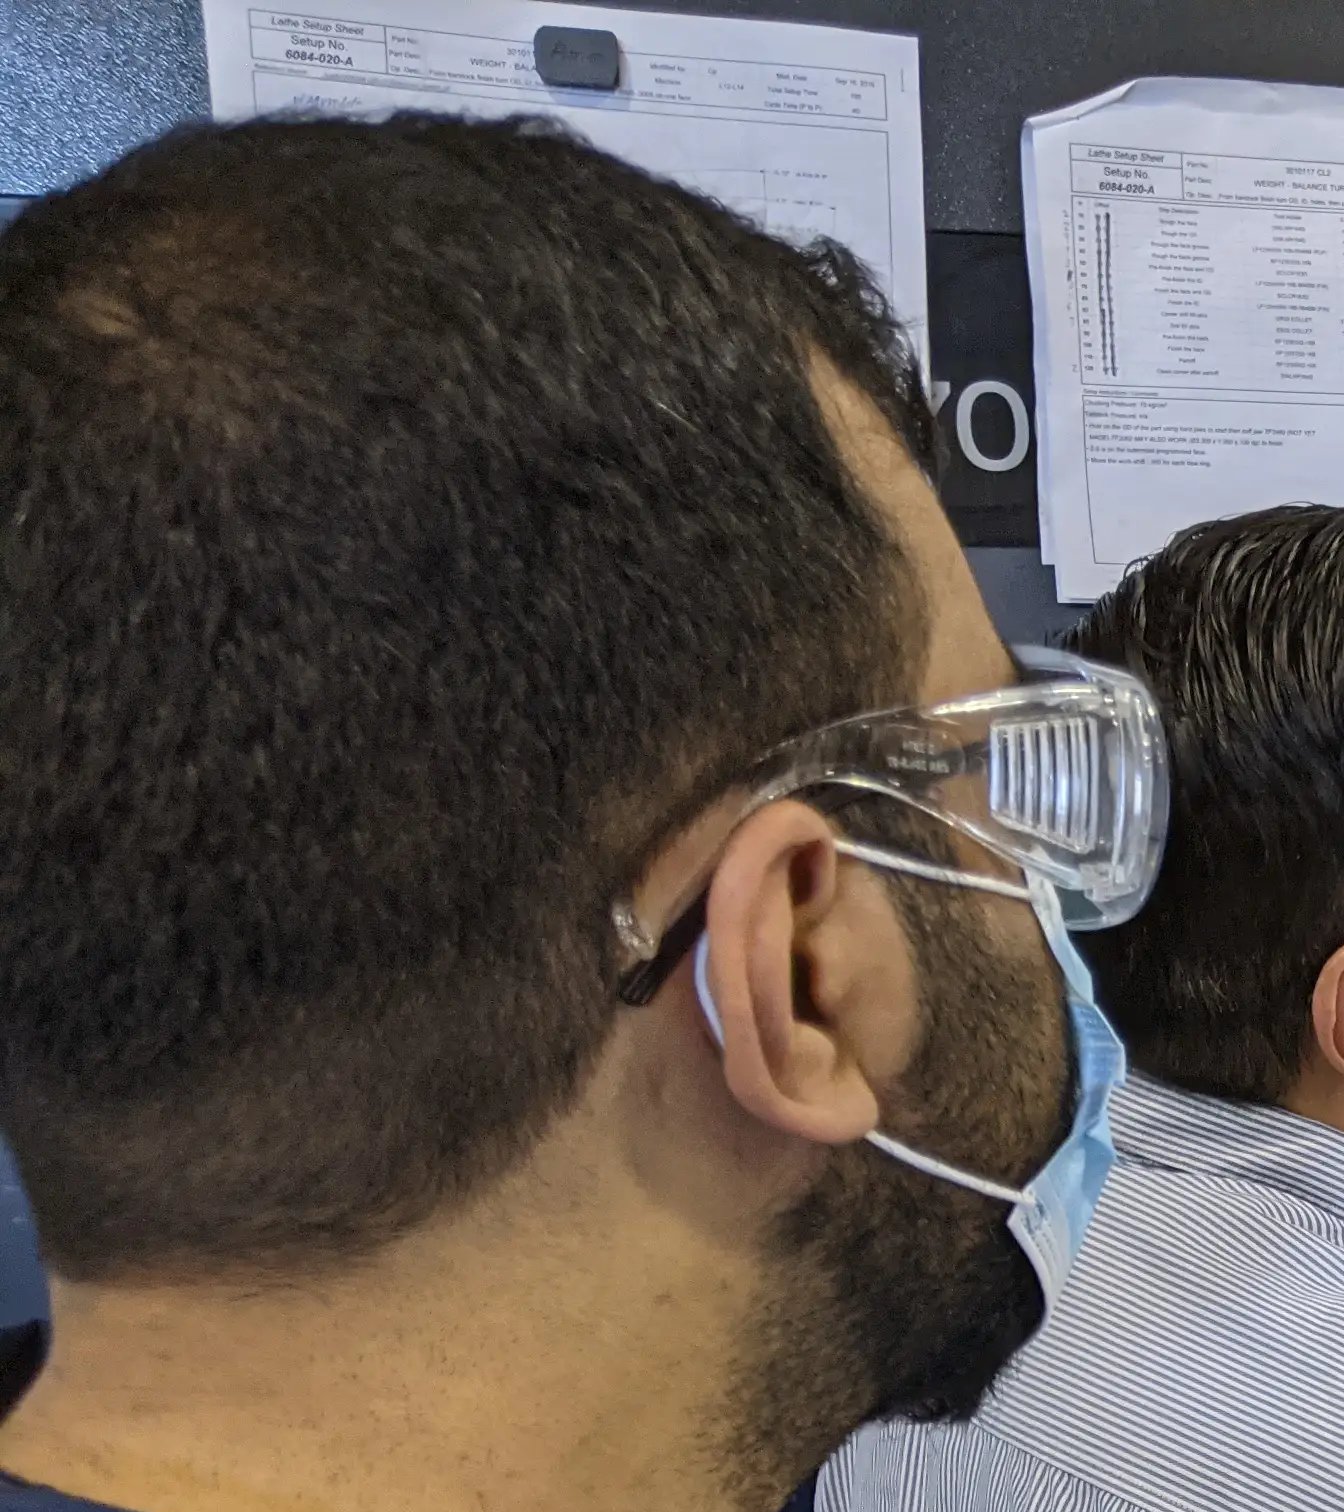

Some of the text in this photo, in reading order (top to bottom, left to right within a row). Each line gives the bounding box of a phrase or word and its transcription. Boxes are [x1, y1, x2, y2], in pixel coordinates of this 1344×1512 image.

[303, 20, 332, 33] Setup
[335, 22, 364, 36] Sheet
[291, 35, 349, 52] Setup No.
[285, 50, 354, 68] 6084-020-A
[470, 57, 506, 70] WEIGHT
[1113, 150, 1138, 163] Setup
[1140, 152, 1164, 163] Sheet
[1104, 166, 1150, 180] Setup No.
[1098, 181, 1155, 195] 6084-020-A
[1253, 180, 1285, 190] WEIGHT
[1292, 181, 1327, 192] BALANCE
